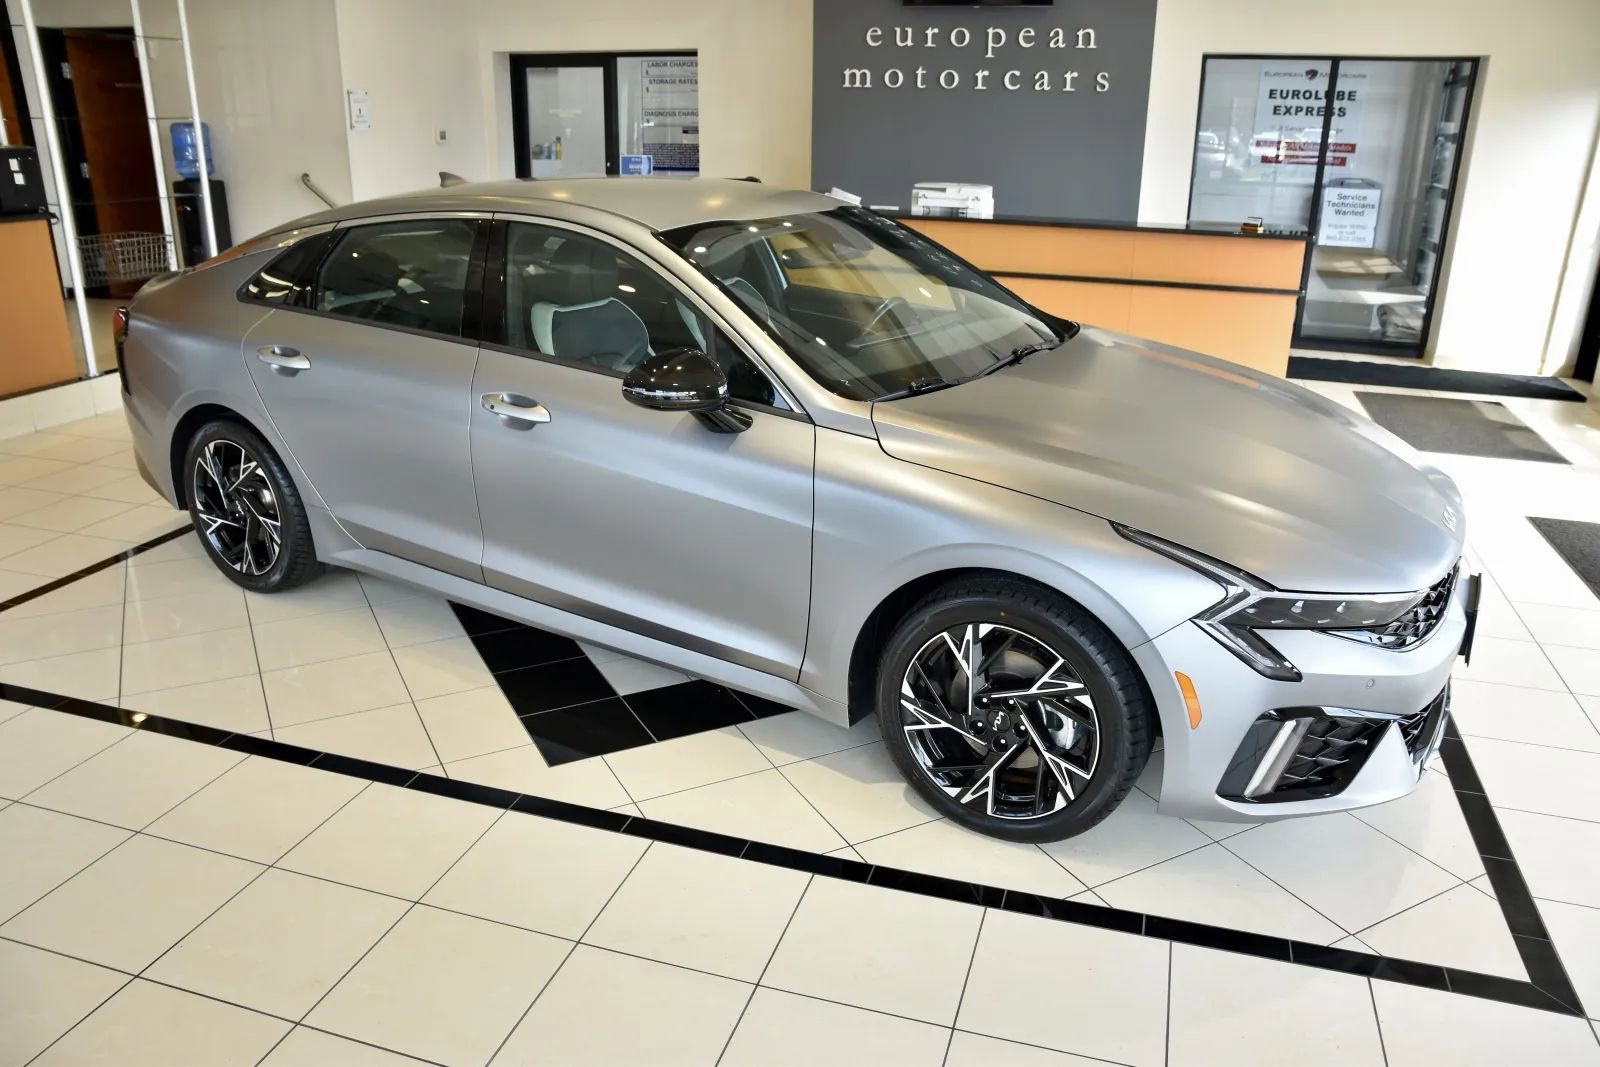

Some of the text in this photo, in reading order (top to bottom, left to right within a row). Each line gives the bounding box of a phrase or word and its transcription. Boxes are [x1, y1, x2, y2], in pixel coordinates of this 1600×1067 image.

[865, 26, 1098, 58] european
[841, 66, 1110, 92] motorcars
[1336, 193, 1368, 201] Service
[1327, 200, 1376, 209] Technicians
[1334, 208, 1365, 217] Wanted
